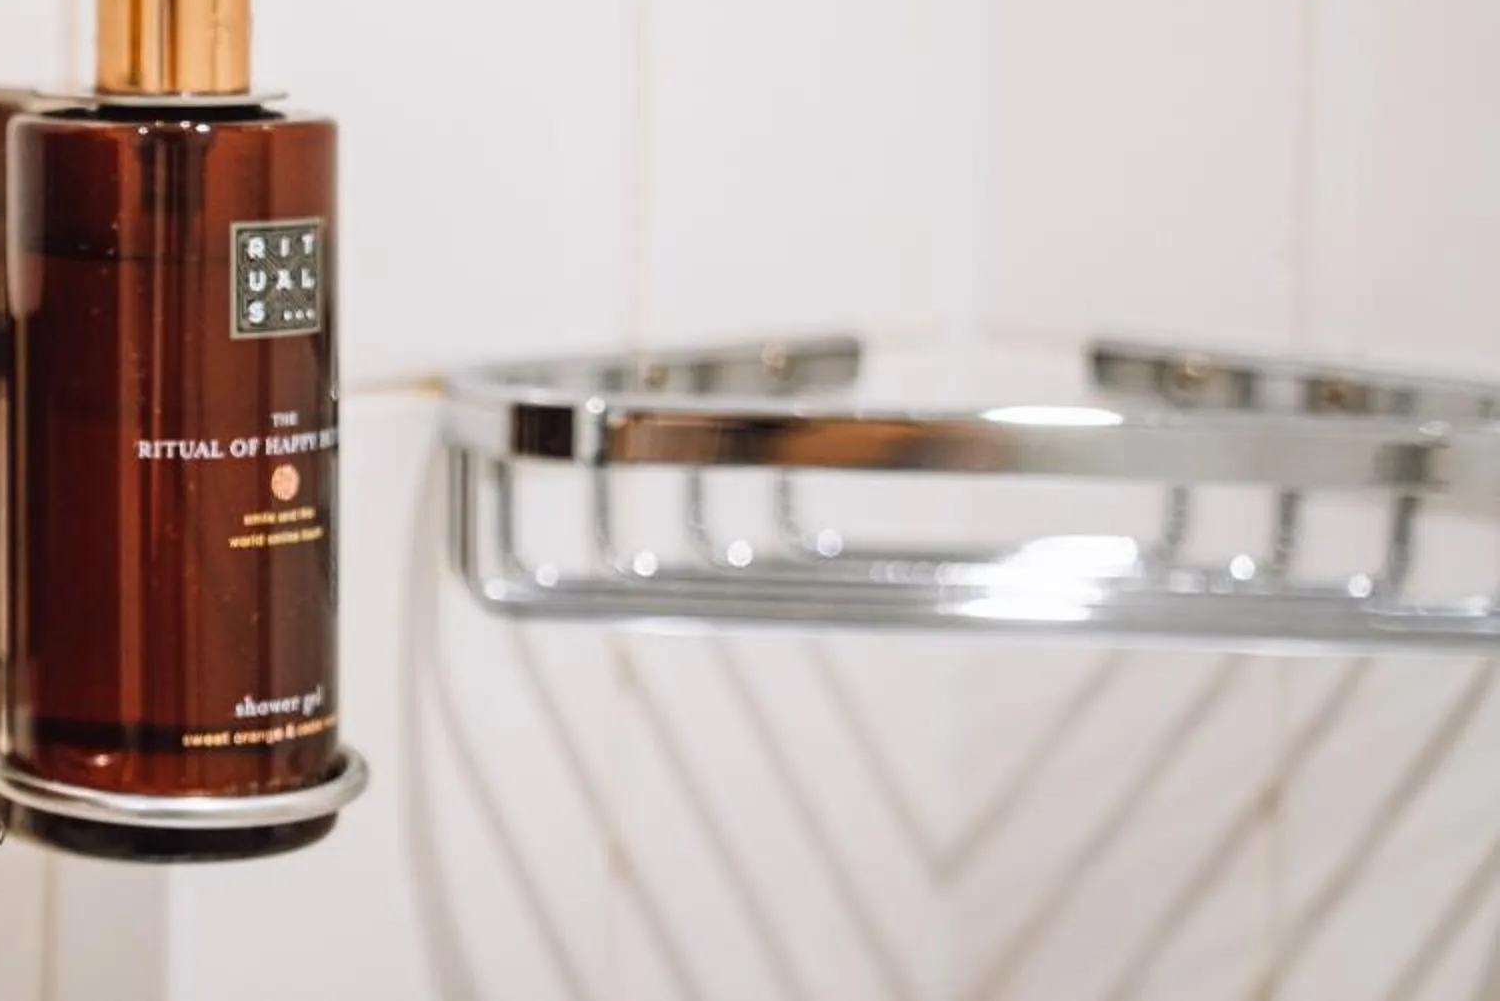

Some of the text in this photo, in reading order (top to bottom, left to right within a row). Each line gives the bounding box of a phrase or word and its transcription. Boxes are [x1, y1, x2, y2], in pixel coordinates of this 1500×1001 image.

[271, 411, 299, 428] THE
[136, 439, 225, 460] RITUAL
[229, 437, 261, 458] OF
[265, 431, 317, 457] HAPPY
[234, 695, 300, 719] shower
[181, 730, 231, 747] sweet
[233, 727, 284, 744] orange
